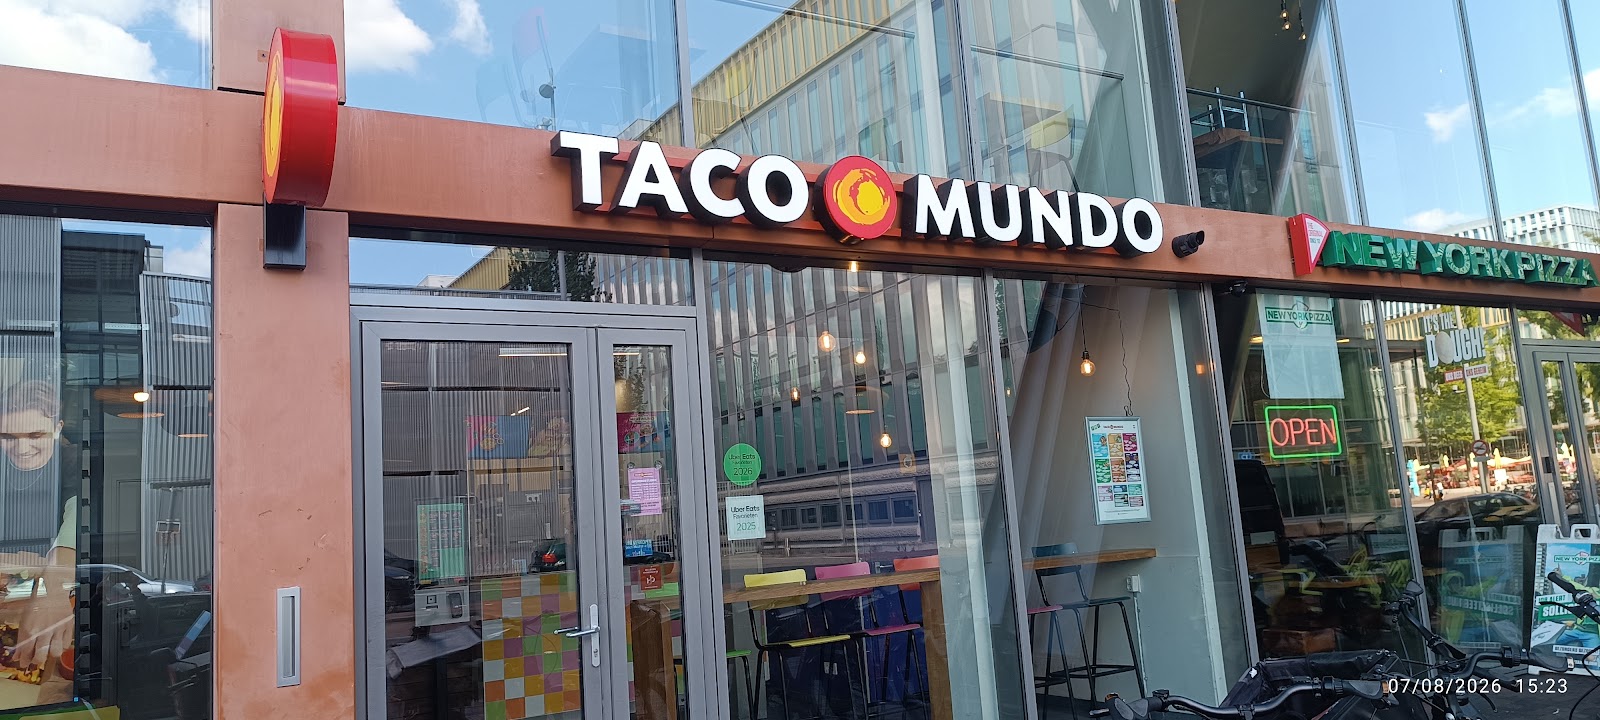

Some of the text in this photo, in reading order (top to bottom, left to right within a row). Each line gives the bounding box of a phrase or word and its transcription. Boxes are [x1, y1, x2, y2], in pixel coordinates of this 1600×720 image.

[559, 131, 1164, 253] TACO MUNDO
[1330, 231, 1600, 287] NEW YORK PIZZA
[1267, 310, 1331, 322] NEW YORK PIZZA
[1423, 311, 1457, 333] IT'S THE
[1270, 418, 1337, 446] OPEN
[733, 467, 753, 476] 2026
[733, 512, 759, 520] Favorieten
[736, 521, 757, 532] 2025
